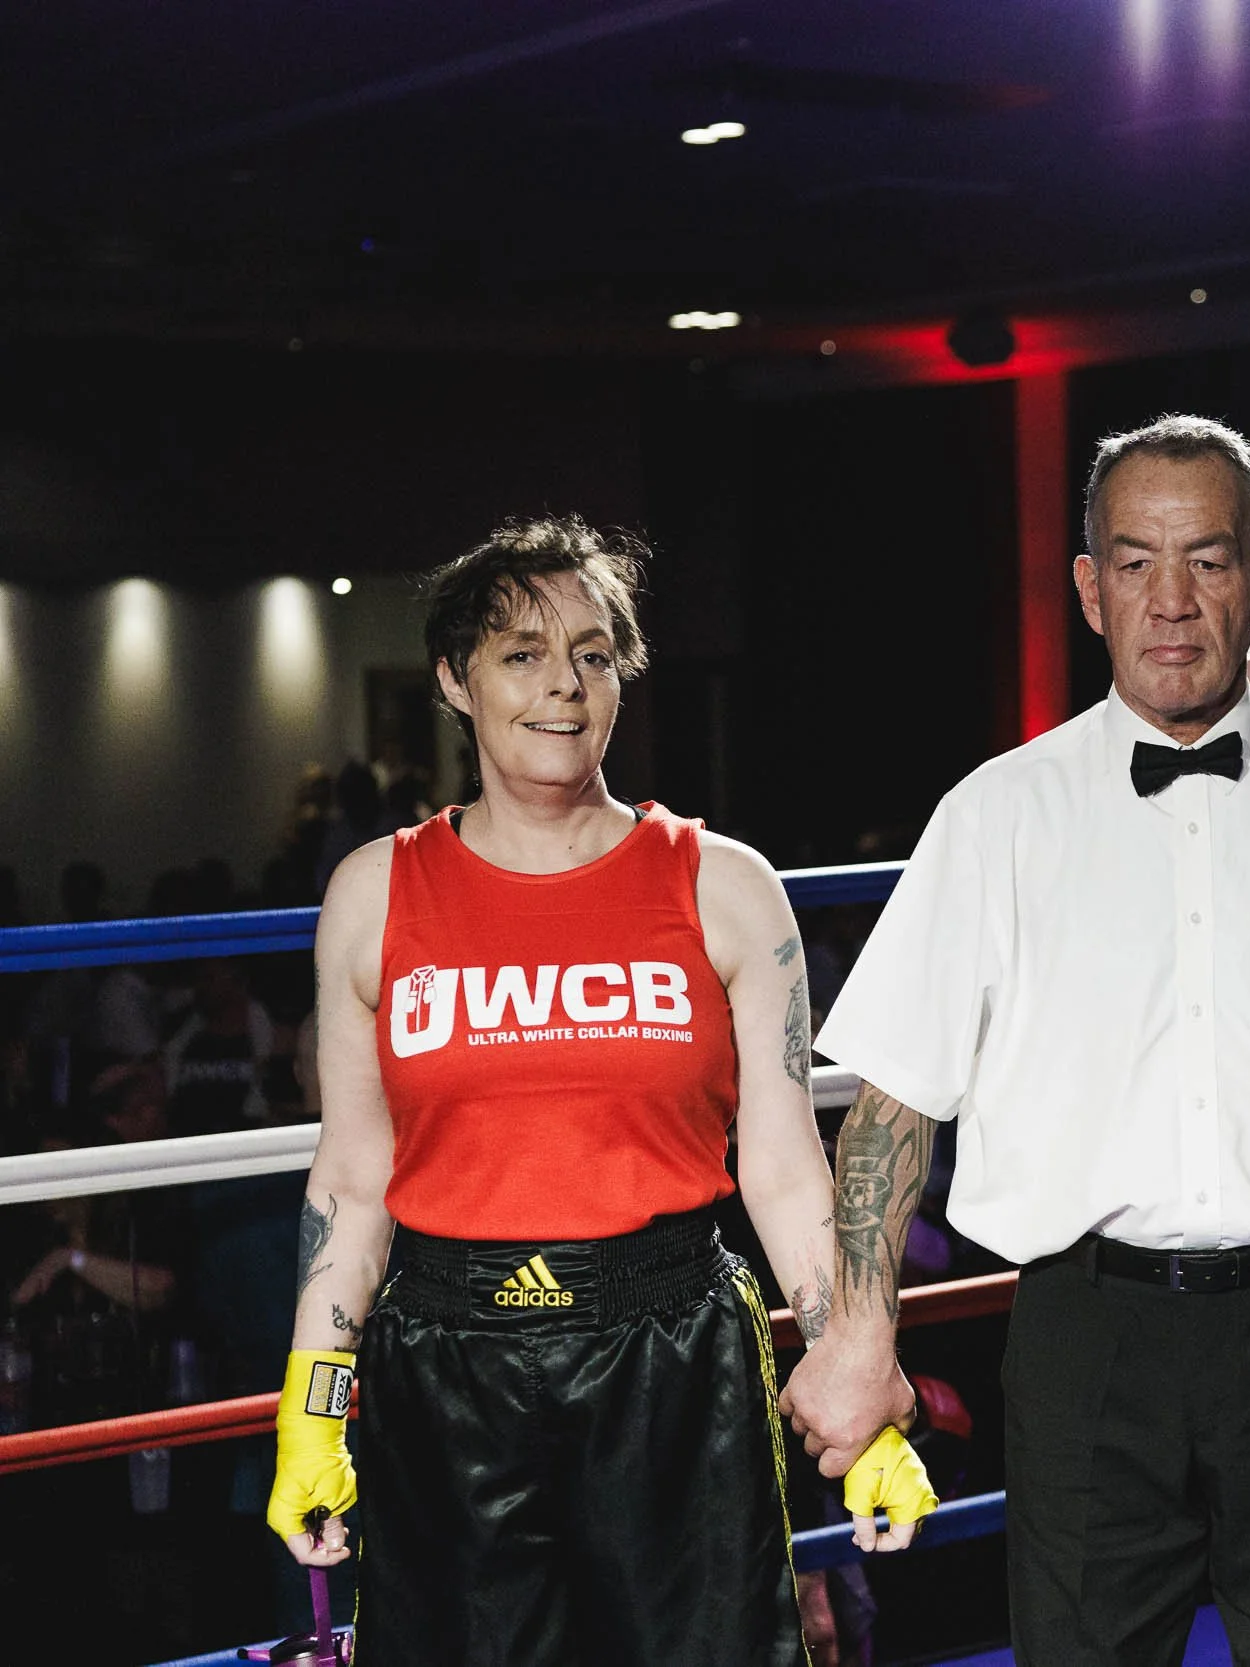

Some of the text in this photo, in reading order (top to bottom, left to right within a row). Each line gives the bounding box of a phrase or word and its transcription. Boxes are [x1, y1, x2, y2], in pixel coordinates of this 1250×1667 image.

[390, 961, 693, 1059] UWCB
[467, 1026, 693, 1046] ULTRA WHITE COLLAR BOXING
[494, 1286, 574, 1307] adidas
[335, 1372, 347, 1412] RDX
